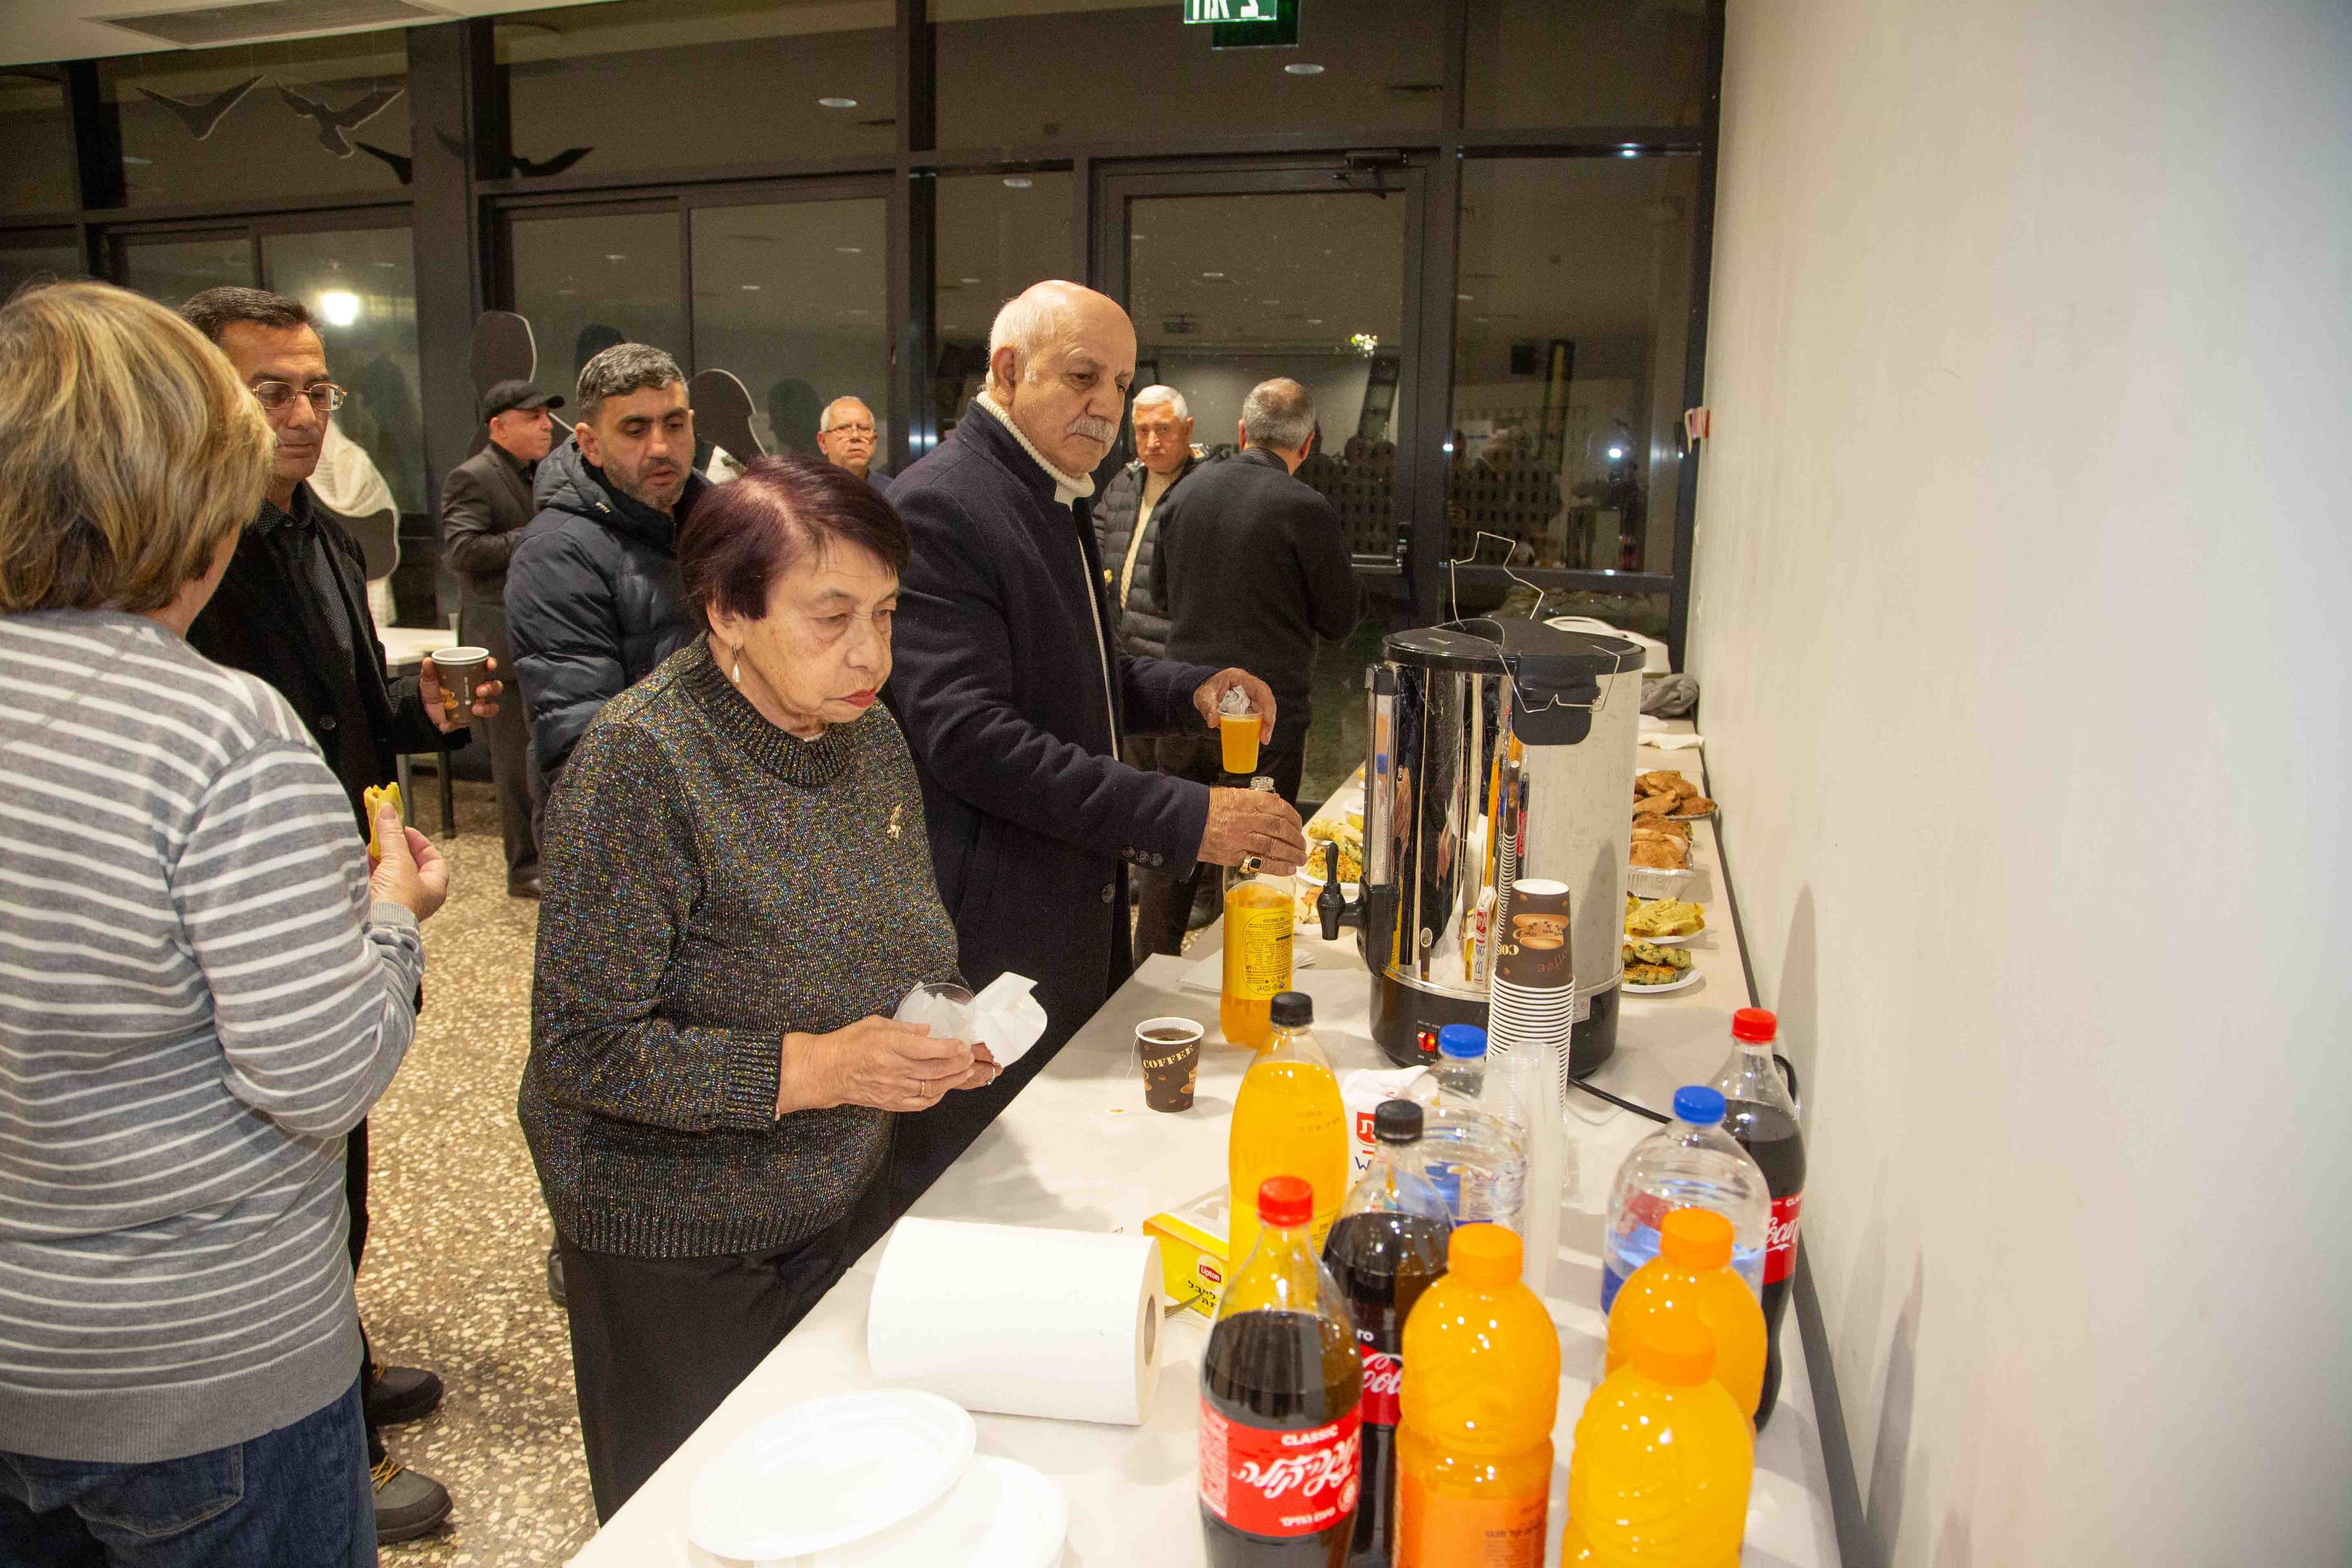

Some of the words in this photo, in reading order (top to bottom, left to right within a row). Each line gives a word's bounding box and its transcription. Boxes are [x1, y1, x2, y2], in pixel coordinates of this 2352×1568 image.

[1143, 1044, 1194, 1068] COFFEE
[1200, 1266, 1219, 1281] Lipton
[1281, 1425, 1339, 1446] CLASSIC
